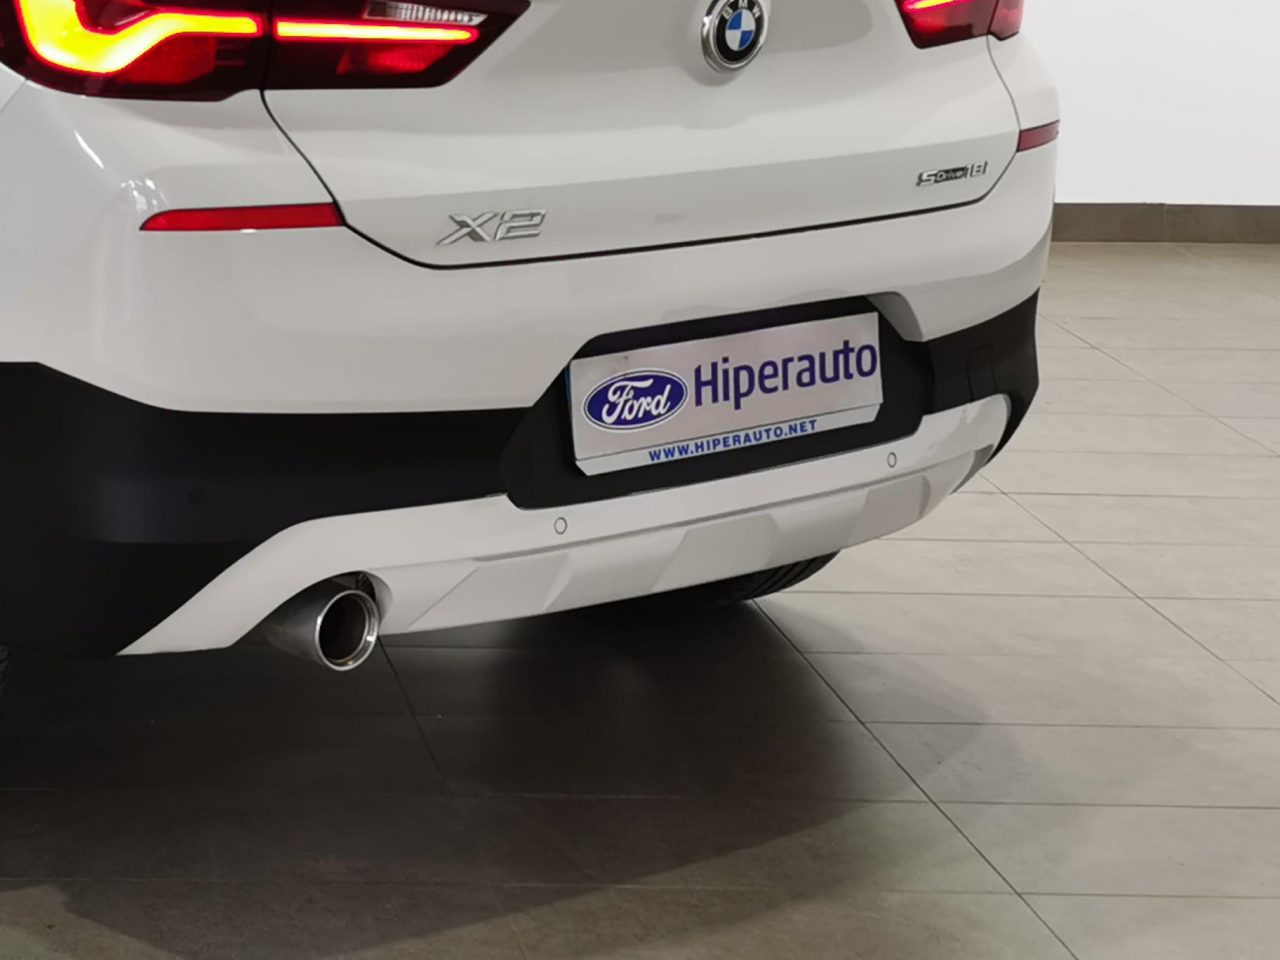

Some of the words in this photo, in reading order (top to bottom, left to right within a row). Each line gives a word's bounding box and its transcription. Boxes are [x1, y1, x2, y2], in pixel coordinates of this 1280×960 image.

[435, 208, 547, 246] X2
[601, 377, 671, 424] Ford
[693, 339, 878, 411] Hiperauto
[648, 418, 818, 463] WWW.HIPERAUTO.NET
